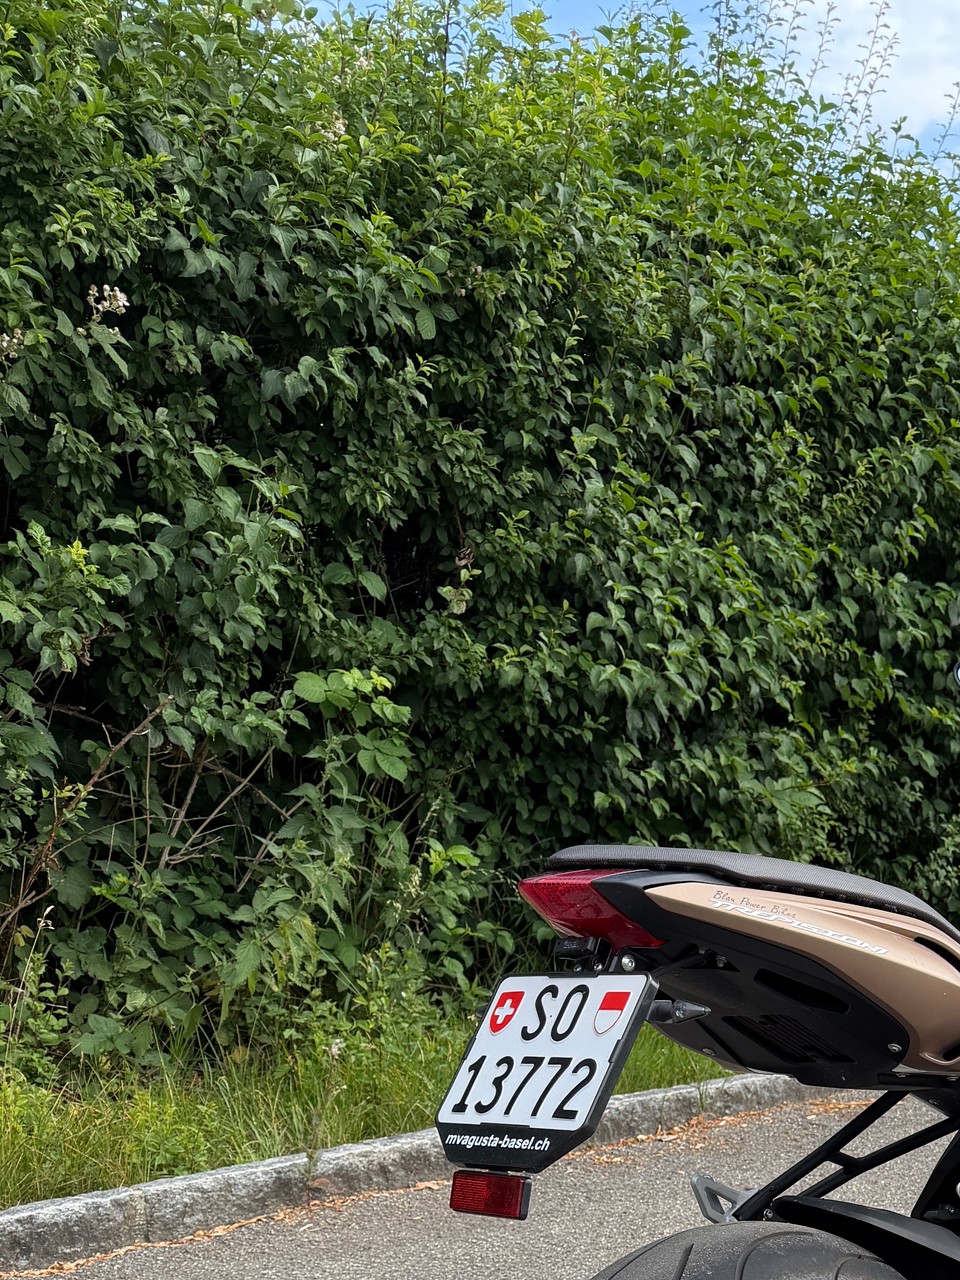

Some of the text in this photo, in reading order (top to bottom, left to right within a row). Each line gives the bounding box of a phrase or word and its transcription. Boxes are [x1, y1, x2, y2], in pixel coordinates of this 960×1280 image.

[740, 897, 766, 909] Power
[770, 905, 797, 918] Bikes
[520, 984, 590, 1041] SO
[451, 1055, 597, 1120] 13772
[445, 1134, 550, 1151] mvagusta-basel.ch
